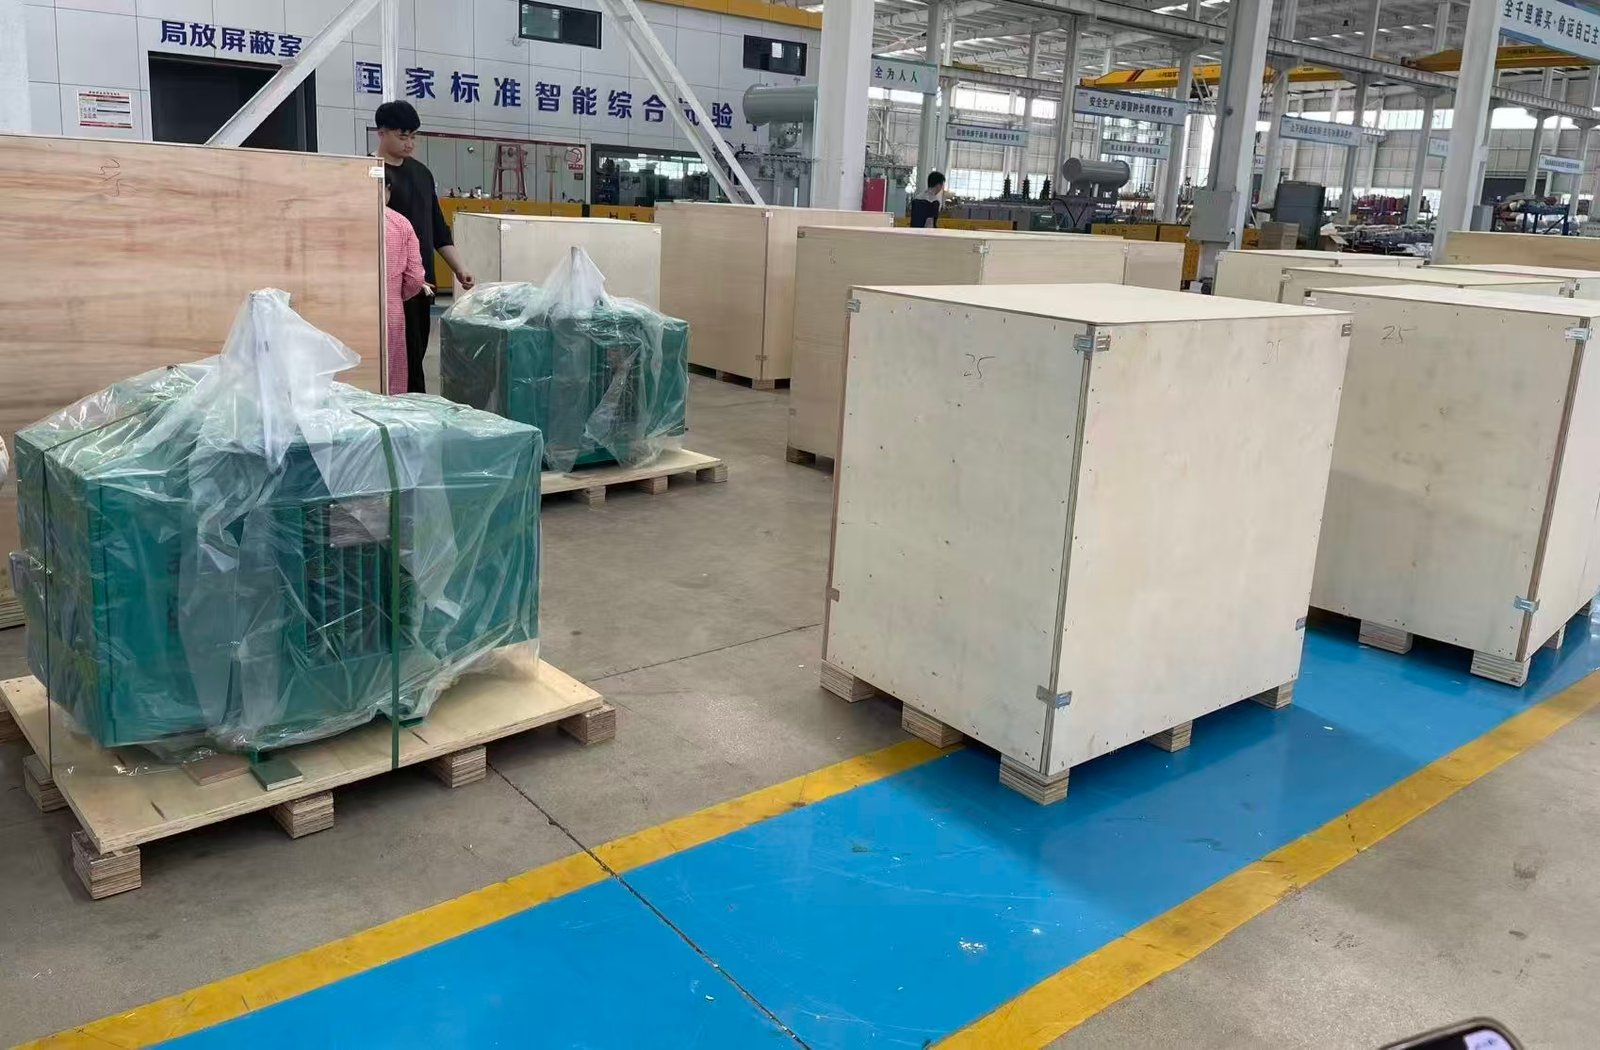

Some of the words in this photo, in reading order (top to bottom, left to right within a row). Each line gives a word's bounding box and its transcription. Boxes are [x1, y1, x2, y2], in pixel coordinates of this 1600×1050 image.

[160, 20, 303, 58] 局放屏蔽室
[355, 61, 758, 132] 国家标准智能综合验
